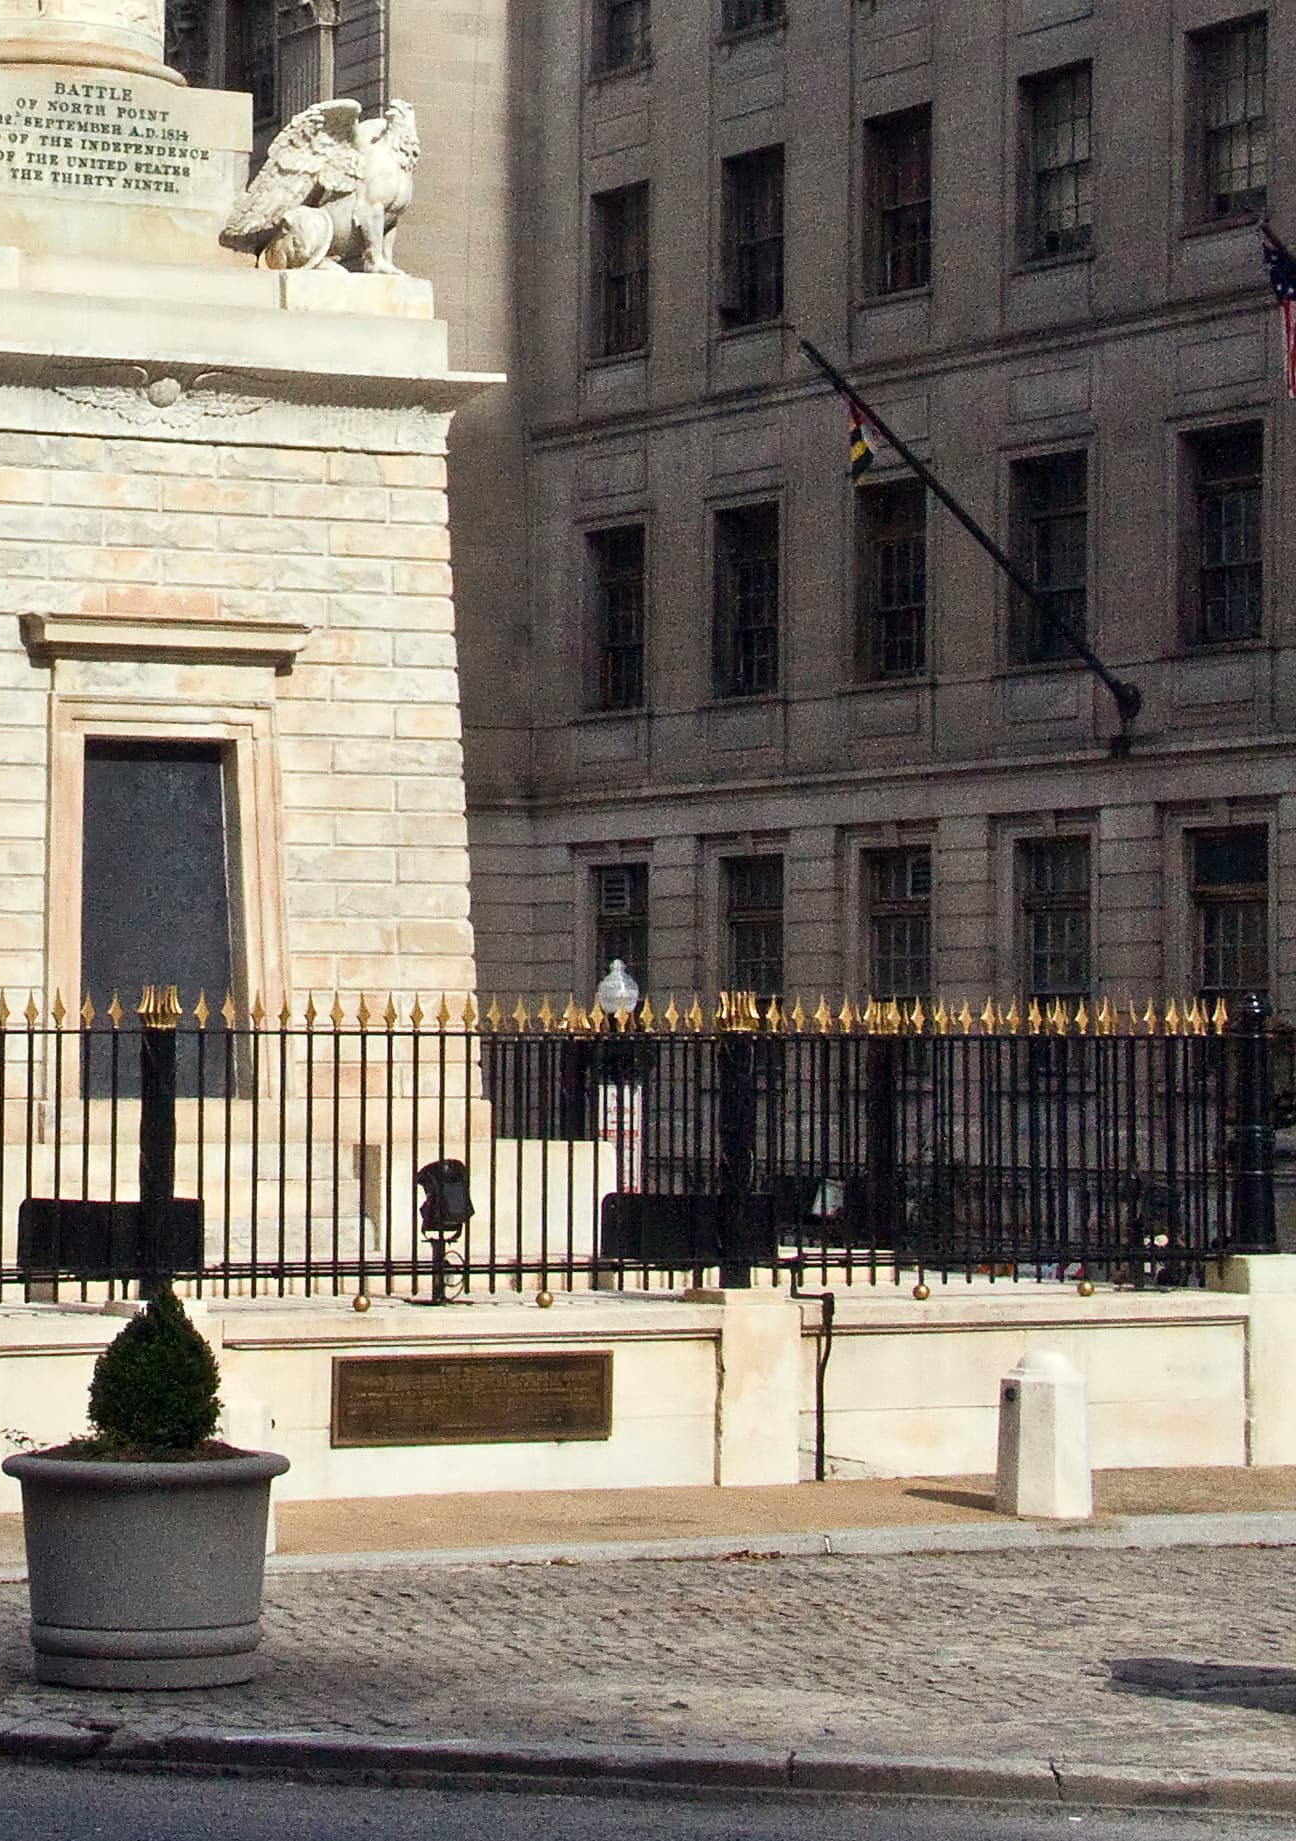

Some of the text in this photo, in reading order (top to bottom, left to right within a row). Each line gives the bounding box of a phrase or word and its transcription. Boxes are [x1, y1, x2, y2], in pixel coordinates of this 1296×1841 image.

[54, 82, 133, 102] BATTLE
[16, 97, 169, 122] OF NORTH POINT
[24, 116, 122, 135] SEPTEMBER
[7, 132, 29, 145] OF
[39, 135, 74, 149] THE
[80, 139, 210, 161] INDEPENDENCE
[25, 152, 59, 166] THE
[66, 156, 127, 172] UNITED
[134, 162, 191, 177] STATES
[10, 167, 180, 194] THE THIRTY NINTH.
